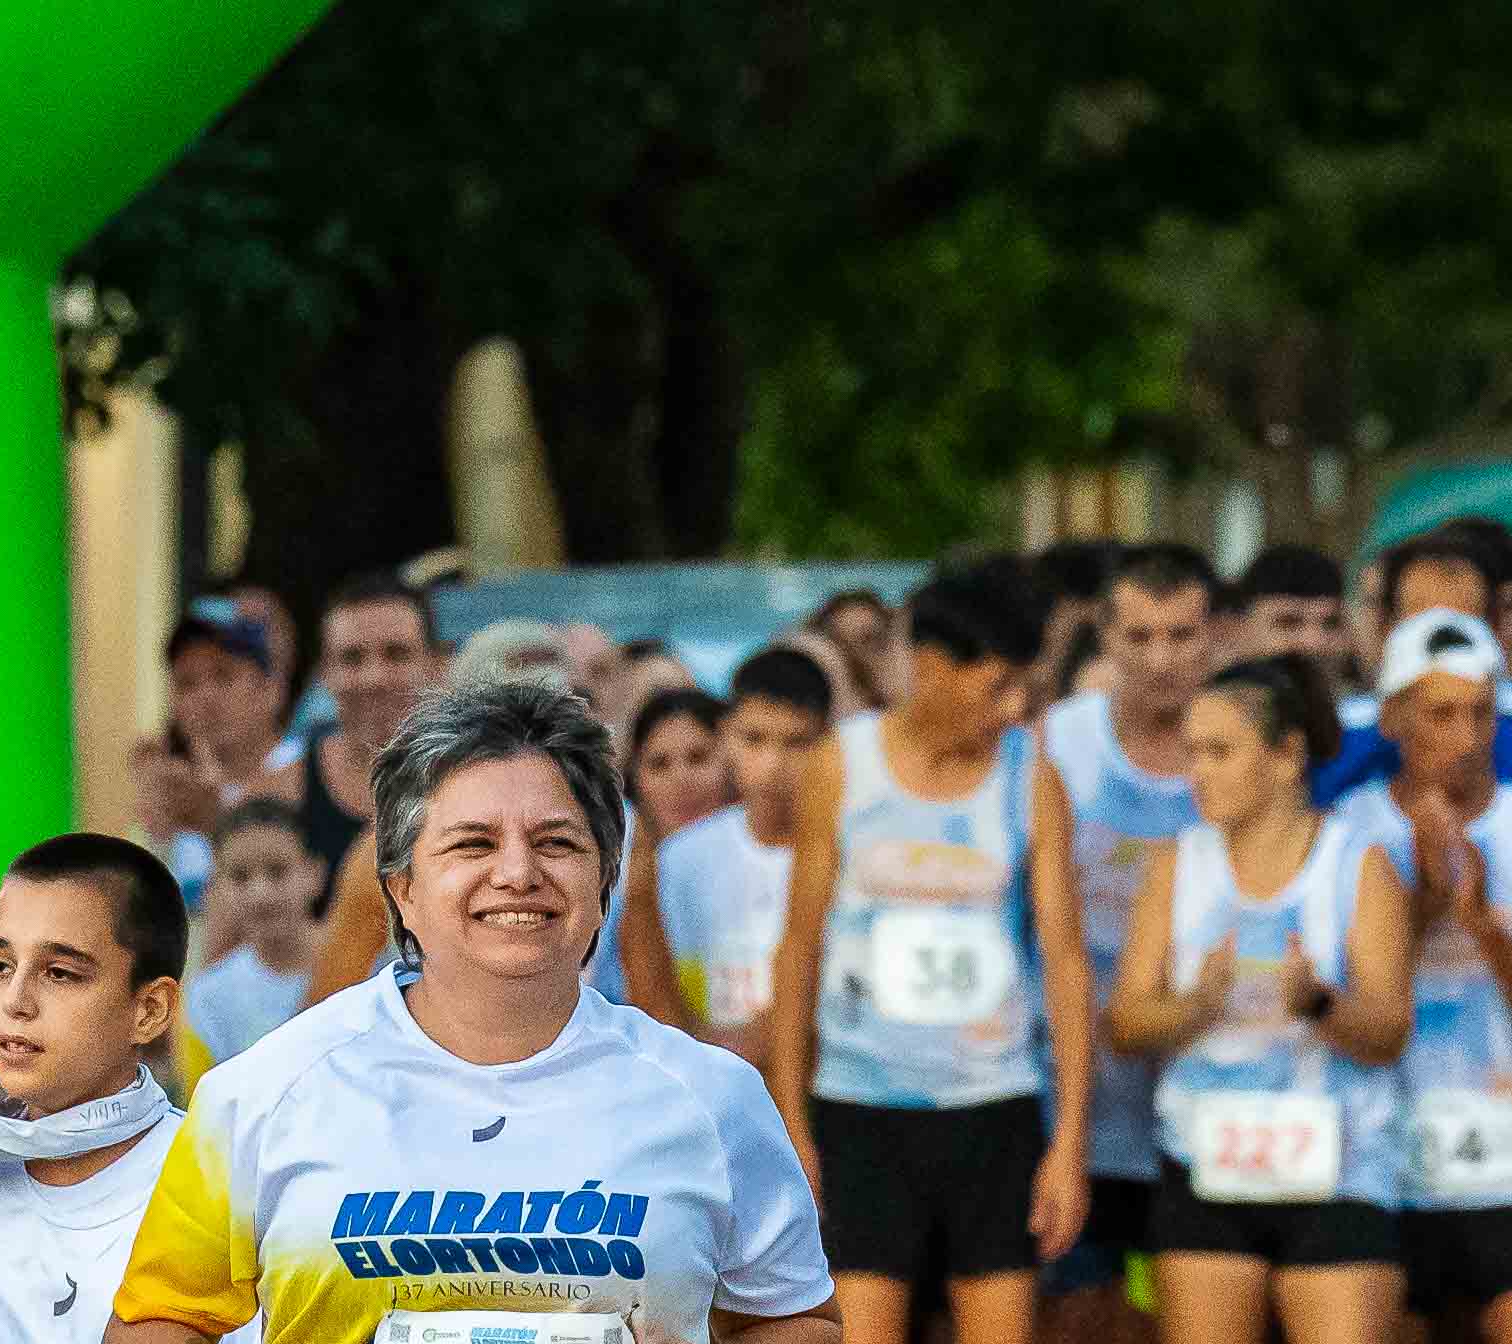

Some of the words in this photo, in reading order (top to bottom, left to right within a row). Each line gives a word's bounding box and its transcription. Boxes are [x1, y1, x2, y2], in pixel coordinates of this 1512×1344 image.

[330, 1179, 650, 1240] MARATÓN
[334, 1237, 646, 1280] ELORTONDO
[392, 1282, 424, 1302] 137
[433, 1280, 592, 1302] ANIVERSARIO
